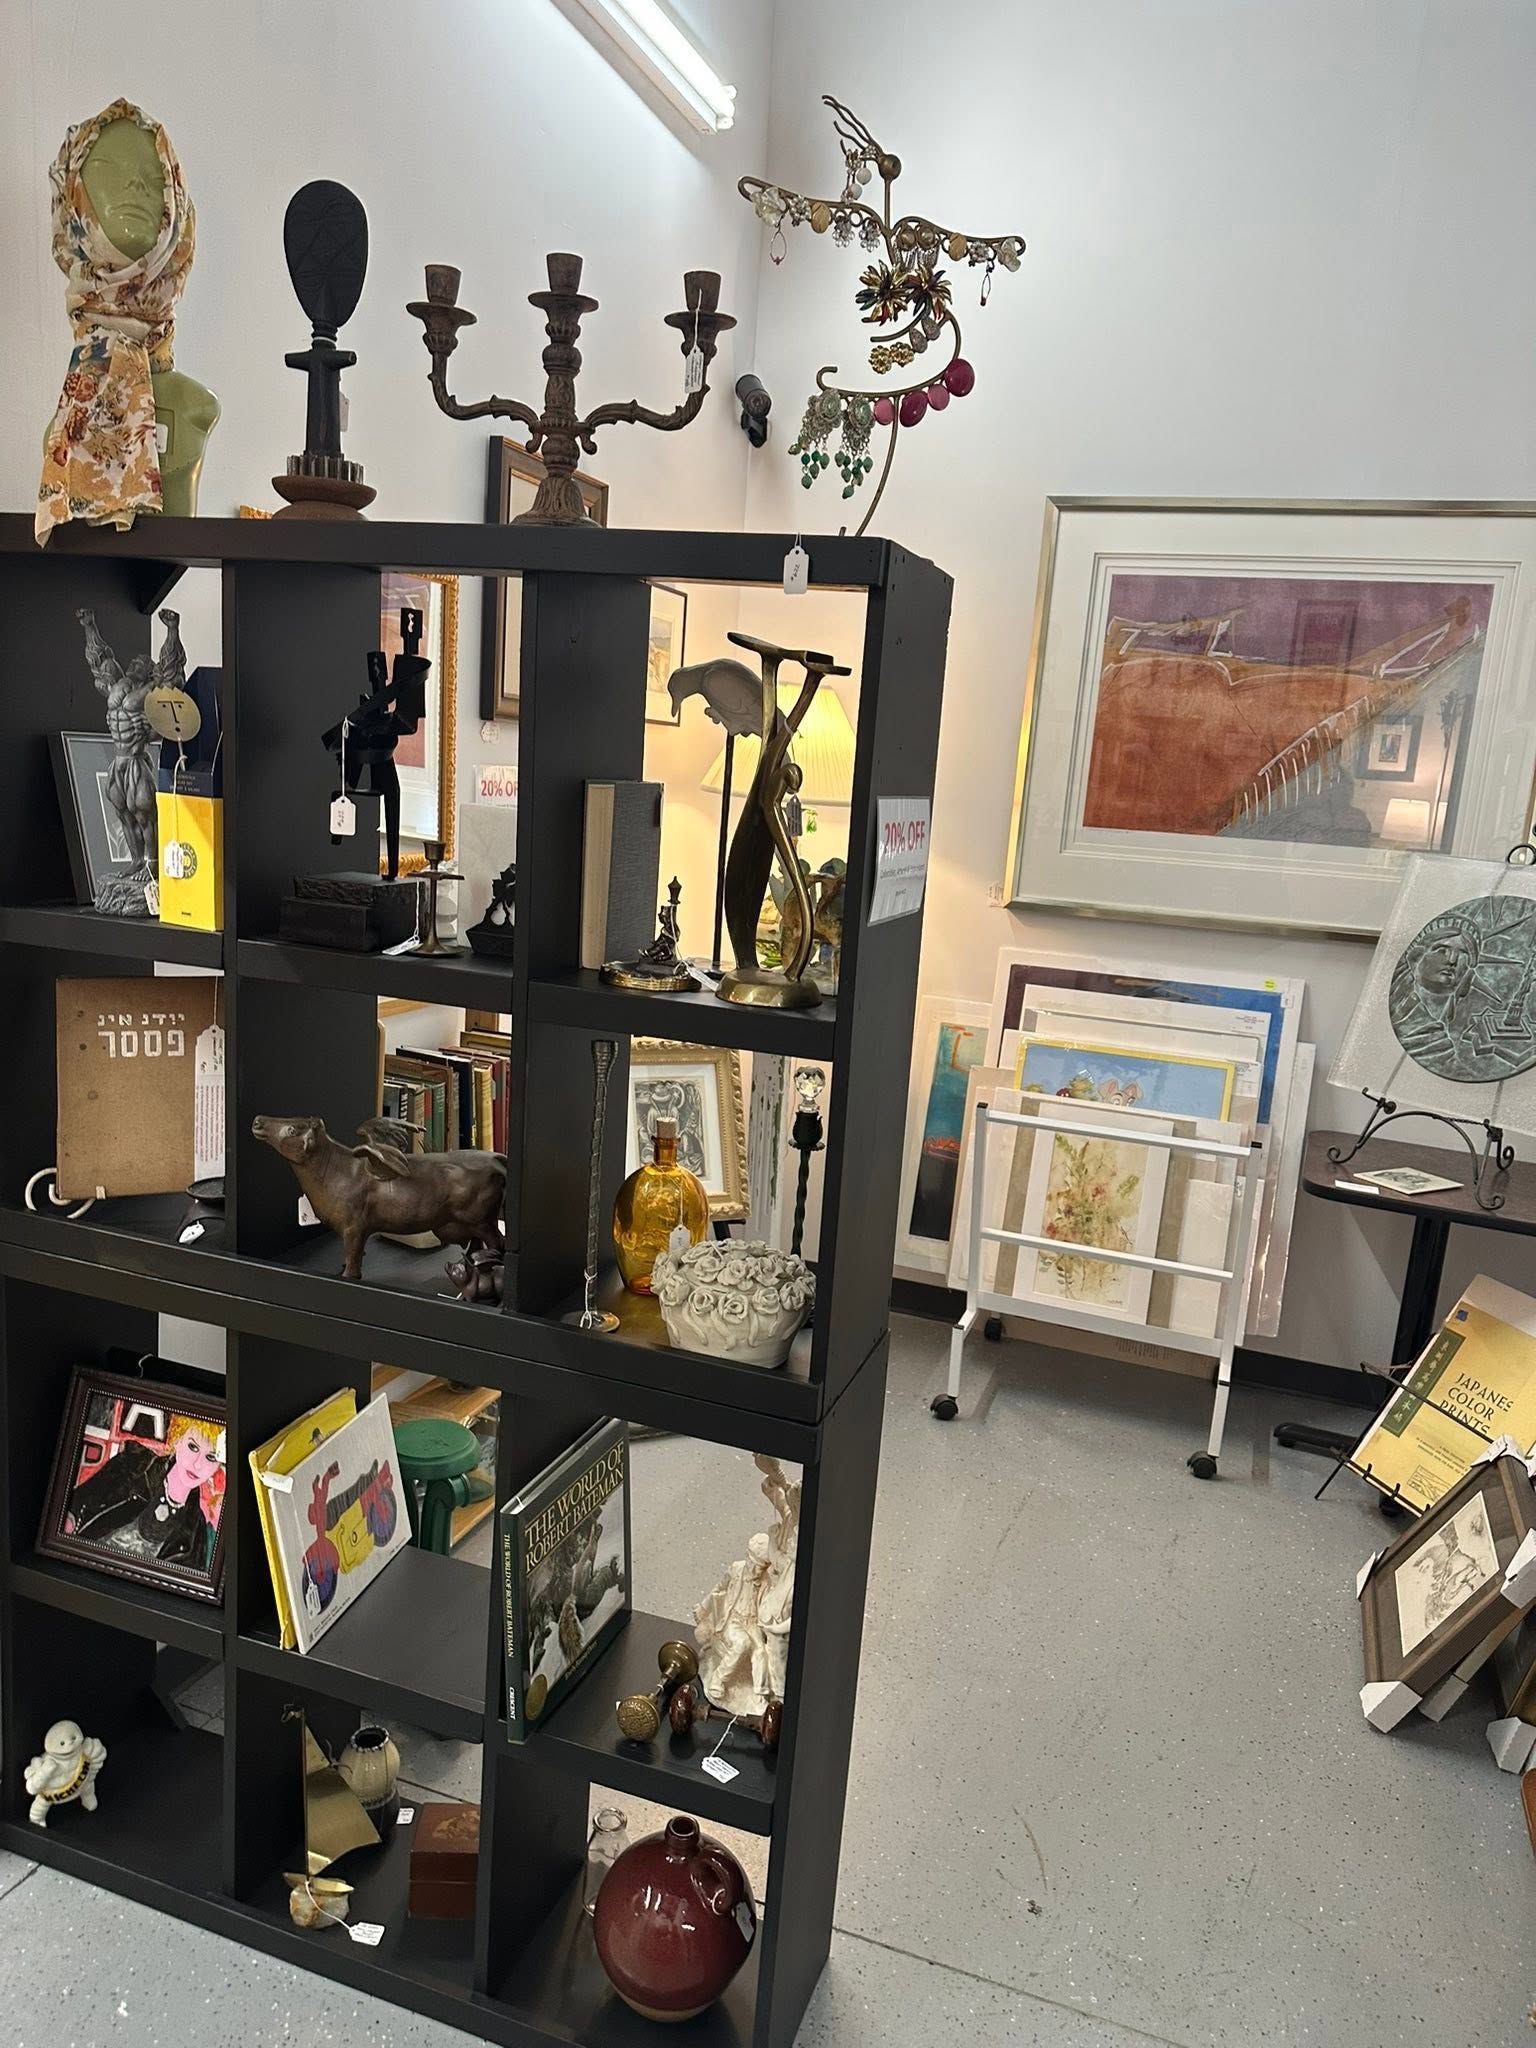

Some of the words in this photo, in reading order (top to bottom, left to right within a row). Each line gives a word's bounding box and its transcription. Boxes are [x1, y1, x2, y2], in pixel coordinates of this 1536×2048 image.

[481, 780, 503, 797] 20%
[885, 821, 905, 854] 20%
[908, 820, 925, 851] OFF
[1440, 1399, 1491, 1434] PRINTS
[1447, 1386, 1495, 1421] COLOR
[525, 1504, 556, 1550] THE
[556, 1459, 606, 1518] WORLD
[607, 1440, 624, 1471] OF
[526, 1512, 572, 1573] ROBERT
[573, 1463, 624, 1526] BATEMAN
[504, 1551, 512, 1578] WORLD
[505, 1590, 513, 1618] ROBERT
[506, 1620, 514, 1658] BATEMAN
[41, 1760, 91, 1802] MICHELIN
